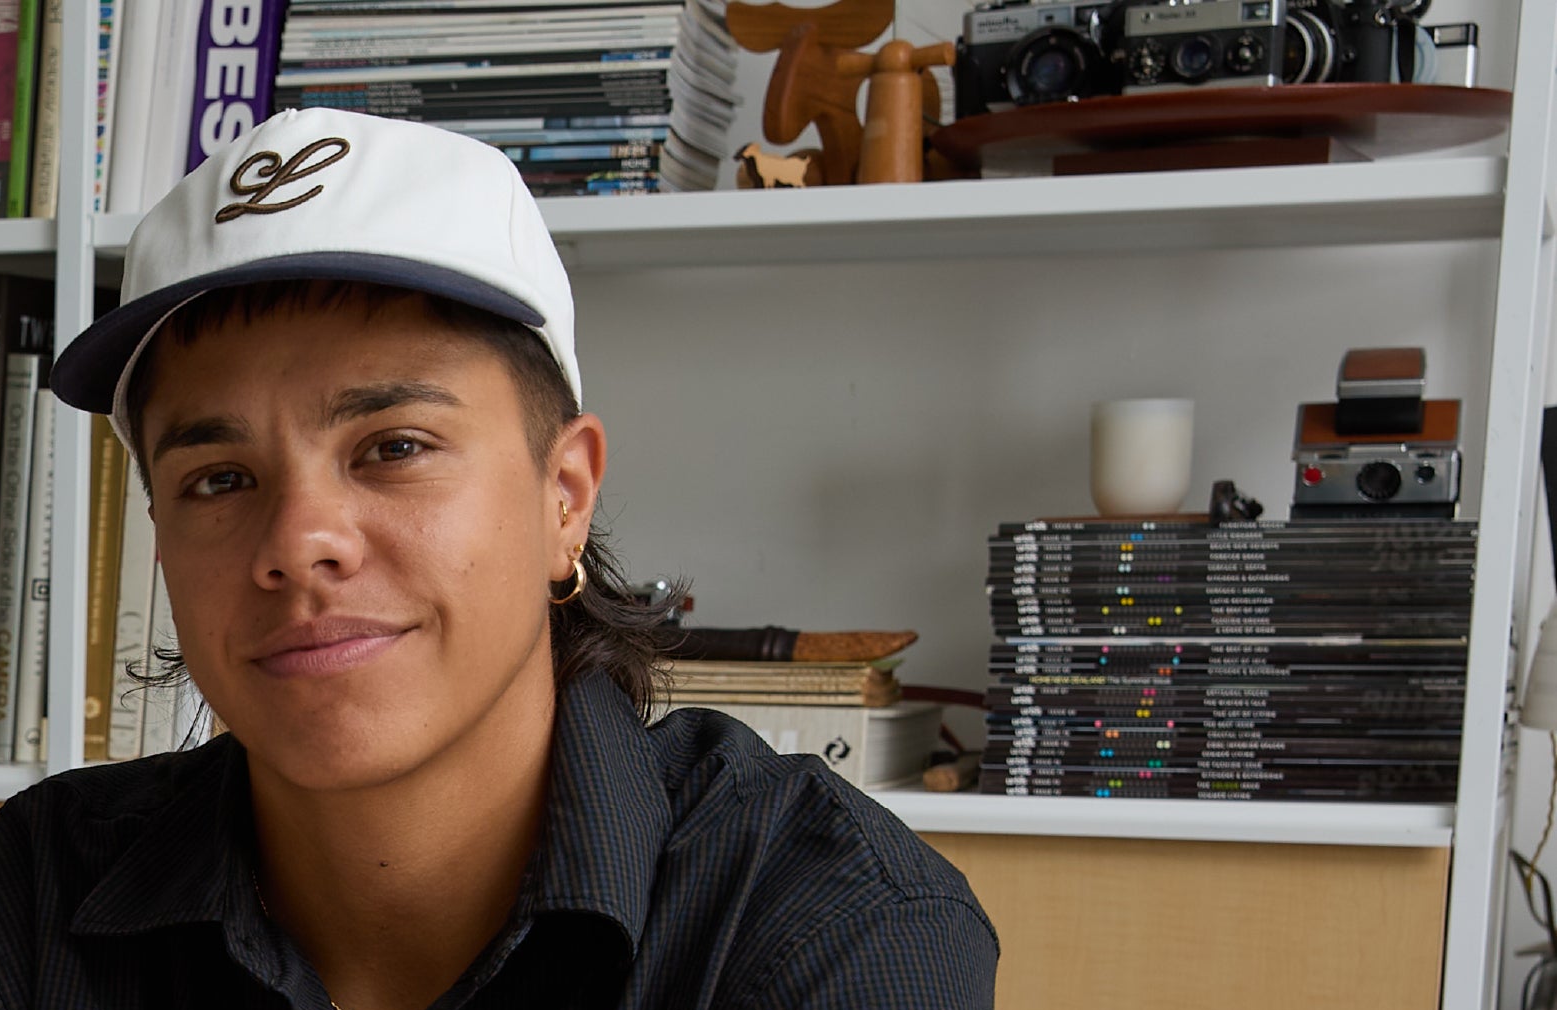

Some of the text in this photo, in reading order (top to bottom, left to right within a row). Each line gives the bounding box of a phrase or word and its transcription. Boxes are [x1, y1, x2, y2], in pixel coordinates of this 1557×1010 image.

[9, 403, 25, 433] On
[4, 470, 22, 523] Other
[1, 527, 19, 569] Side
